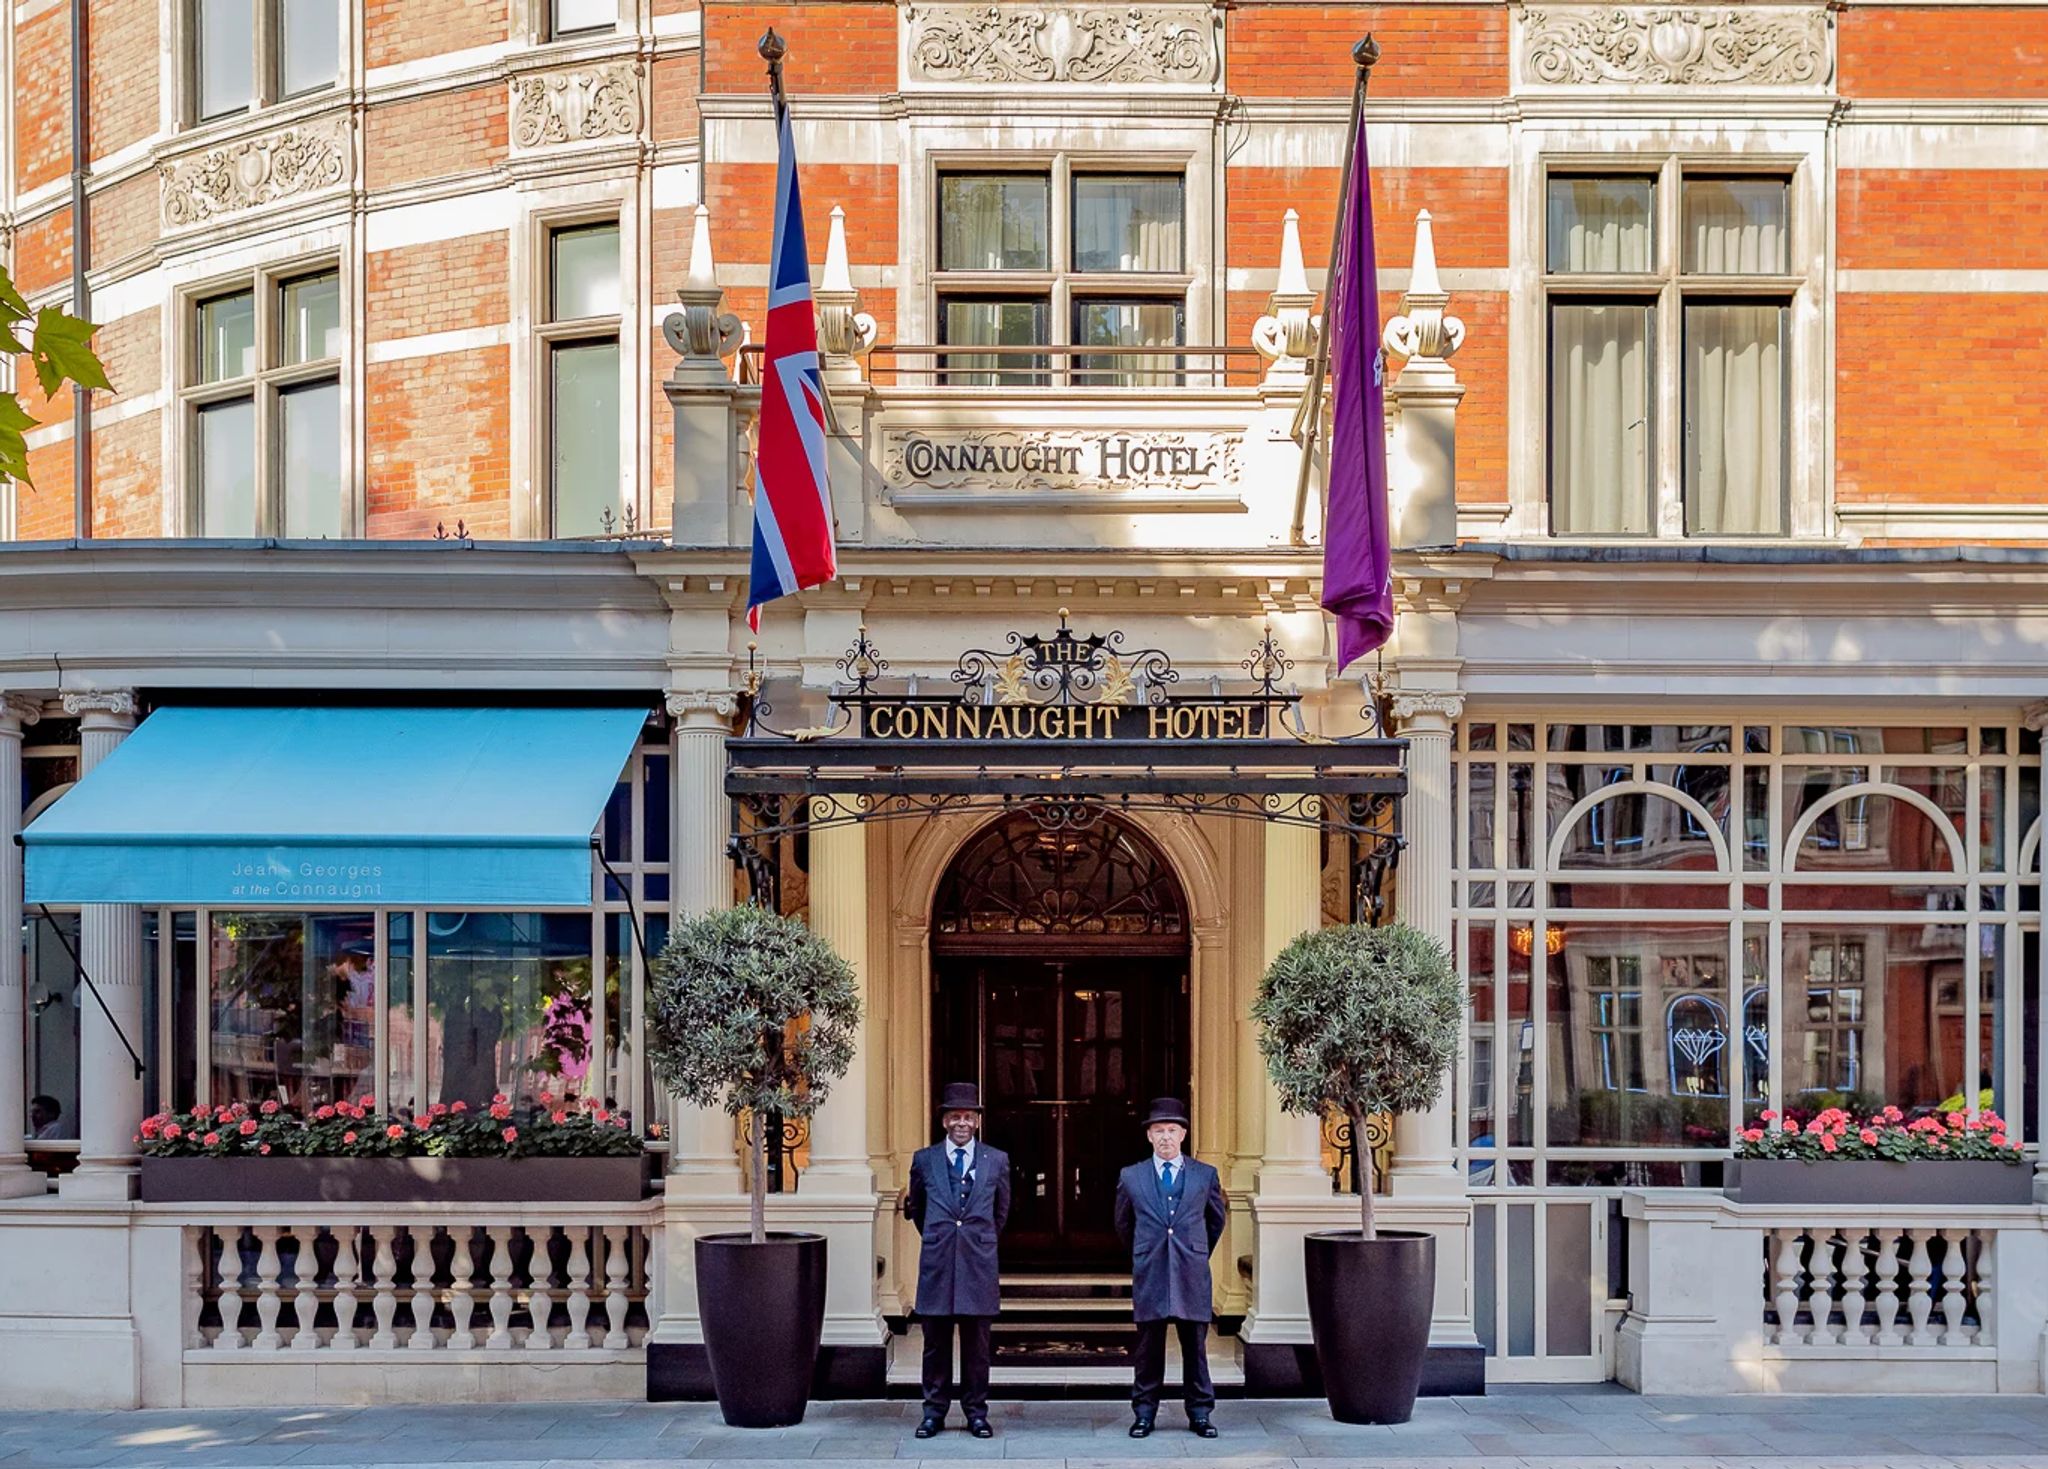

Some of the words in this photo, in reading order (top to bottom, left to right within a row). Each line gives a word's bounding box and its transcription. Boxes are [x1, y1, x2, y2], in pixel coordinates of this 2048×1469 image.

[1097, 439, 1216, 479] HOTEL
[1038, 643, 1093, 662] THE
[869, 706, 1120, 739] CONNAUGHT
[1148, 706, 1265, 739] HOTEL
[300, 863, 382, 879] Georges
[232, 884, 245, 895] at
[250, 884, 270, 895] the
